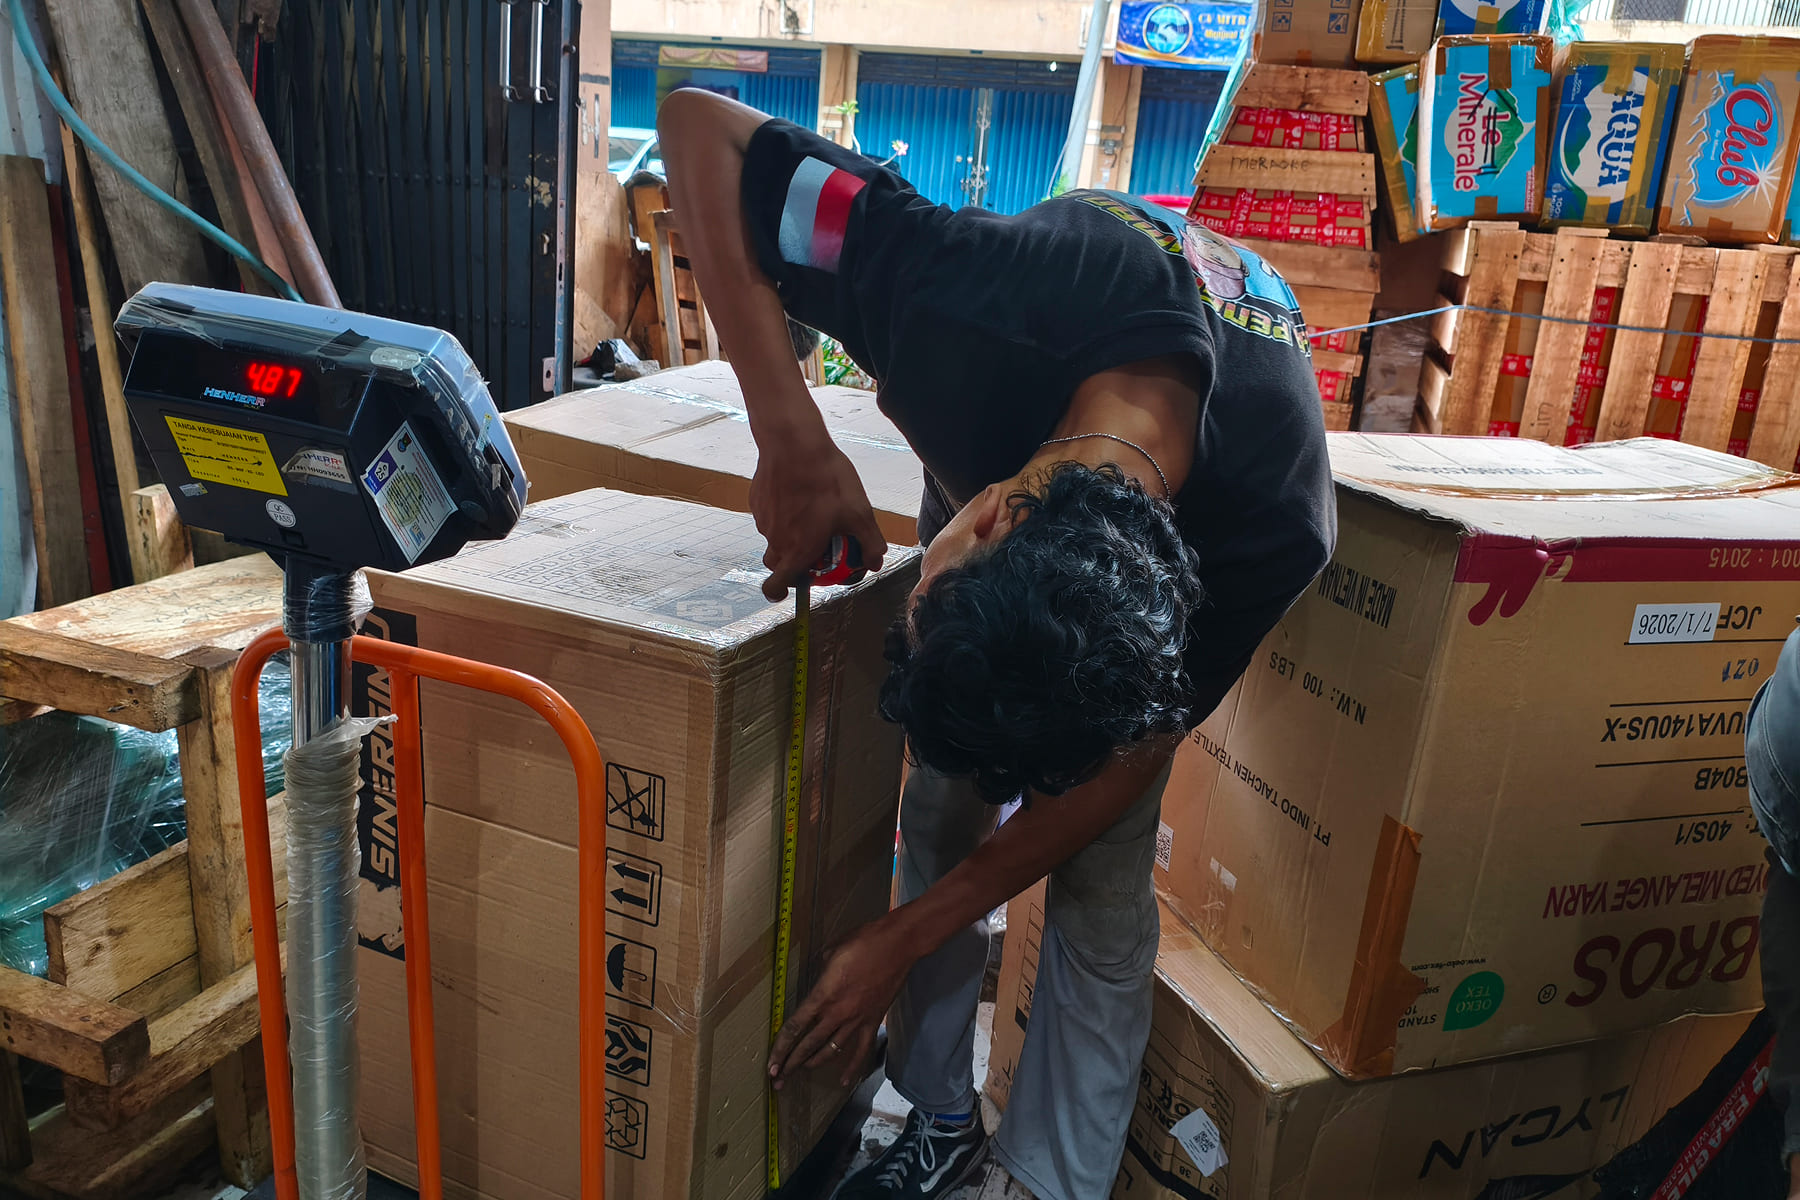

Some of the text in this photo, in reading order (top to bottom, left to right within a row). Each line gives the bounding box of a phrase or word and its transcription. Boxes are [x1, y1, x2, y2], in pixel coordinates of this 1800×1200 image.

[1453, 73, 1487, 191] Minerale
[1480, 110, 1510, 146] Le
[1596, 88, 1645, 188] AQUA
[1716, 88, 1774, 187] Club
[273, 513, 293, 524] PASS
[1708, 547, 1752, 569] 2015
[1365, 579, 1397, 629] MADE
[1638, 611, 1713, 636] 7/1/2026
[1716, 605, 1762, 630] JCF
[1269, 651, 1368, 725] N.W.: 100 LBS
[1600, 711, 1749, 743] UVA140US-X
[1193, 730, 1332, 847] PT. INDO TAICHEN TEXTILE
[1675, 820, 1732, 846] 40S/1
[1542, 863, 1768, 919] YED MELANGE YARN
[1565, 914, 1760, 1009] BROS
[1456, 999, 1492, 1014] OEKO
[1466, 985, 1491, 998] TEX
[1418, 1084, 1631, 1180] LYCAN
[1660, 1080, 1745, 1196] HANDLE WITH CARE
